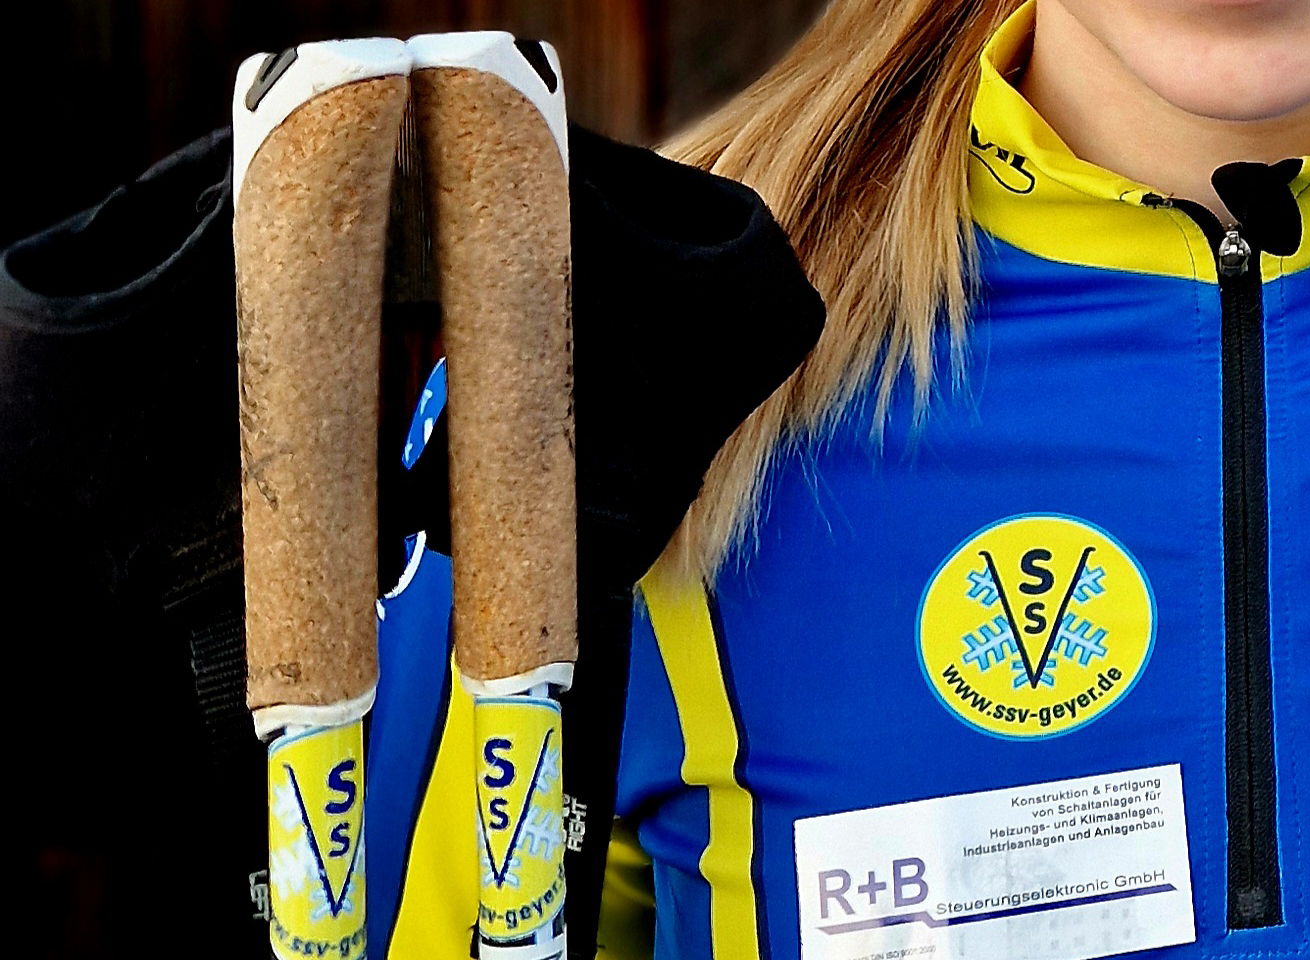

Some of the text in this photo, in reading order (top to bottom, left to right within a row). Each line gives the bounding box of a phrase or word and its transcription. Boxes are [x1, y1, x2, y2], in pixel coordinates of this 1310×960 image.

[941, 663, 1123, 727] www.ssv-geyer.de
[1011, 778, 1161, 807] Konstruktion & Fertigung
[1032, 790, 1162, 818] von Schaltanlagen für
[963, 820, 1165, 858] Industrieanlagen und Anlagenbau
[989, 823, 1050, 840] Heizungs-
[1054, 818, 1076, 830] und
[818, 857, 930, 920] R+B
[936, 869, 1166, 916] Steuerungselektronic GmbH
